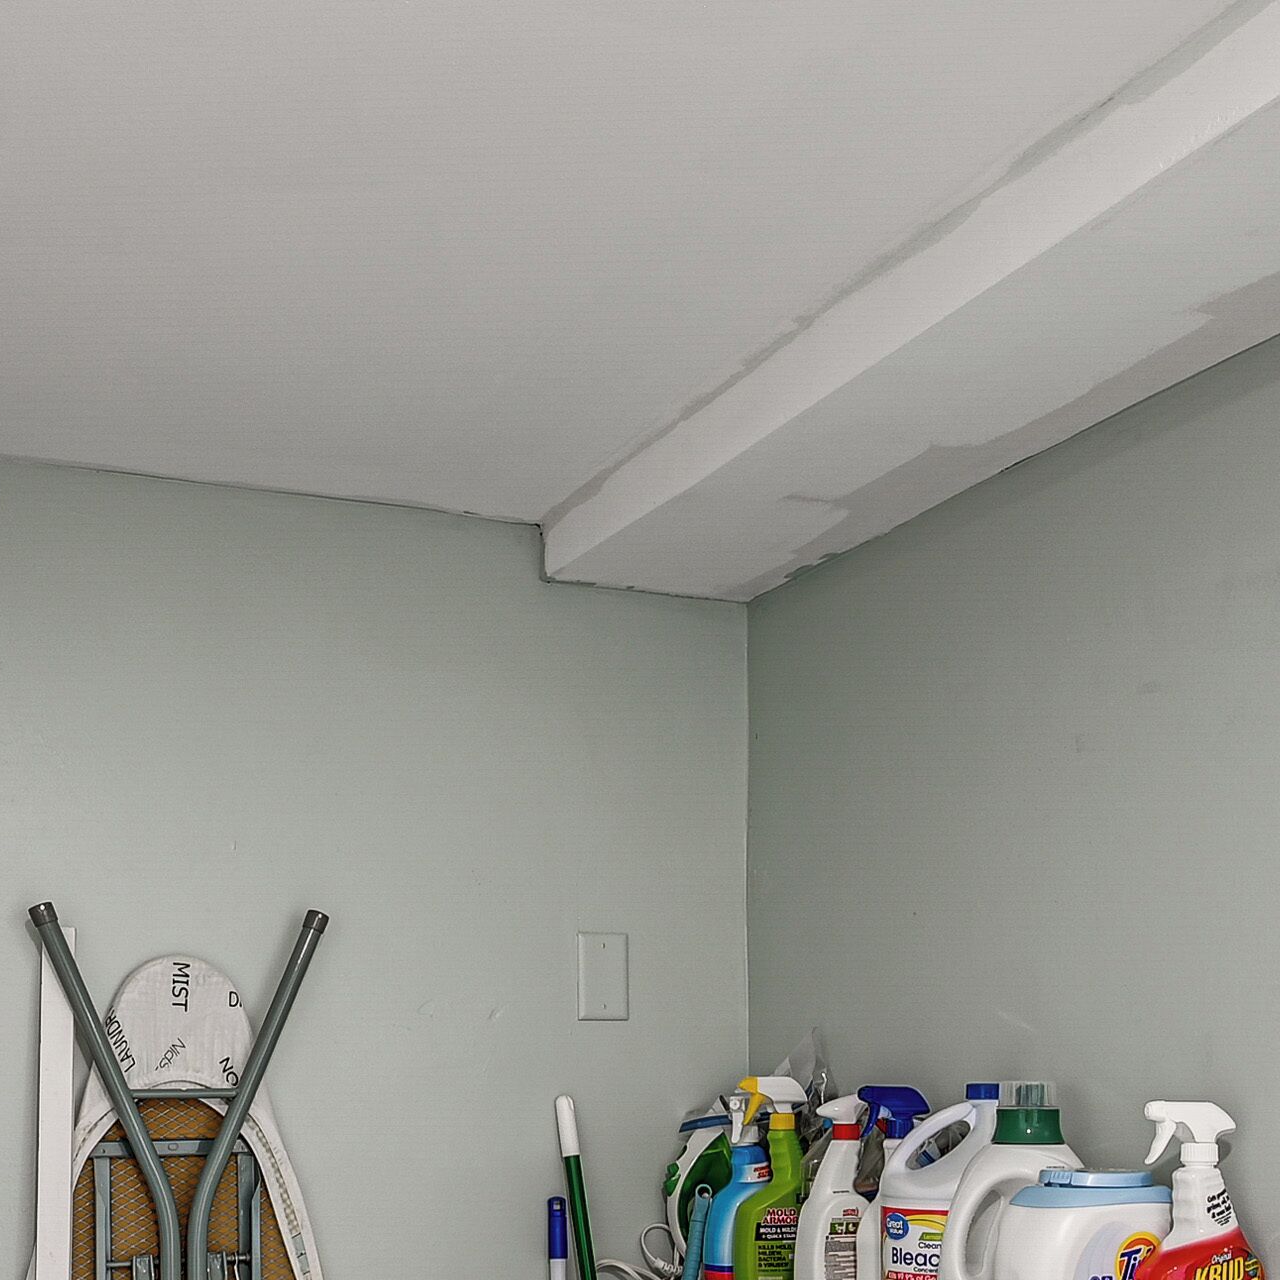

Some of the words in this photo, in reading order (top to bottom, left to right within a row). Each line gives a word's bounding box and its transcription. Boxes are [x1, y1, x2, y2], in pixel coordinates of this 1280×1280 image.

[172, 962, 191, 1012] MIST
[766, 1208, 796, 1217] MOLD
[887, 1217, 903, 1229] Great
